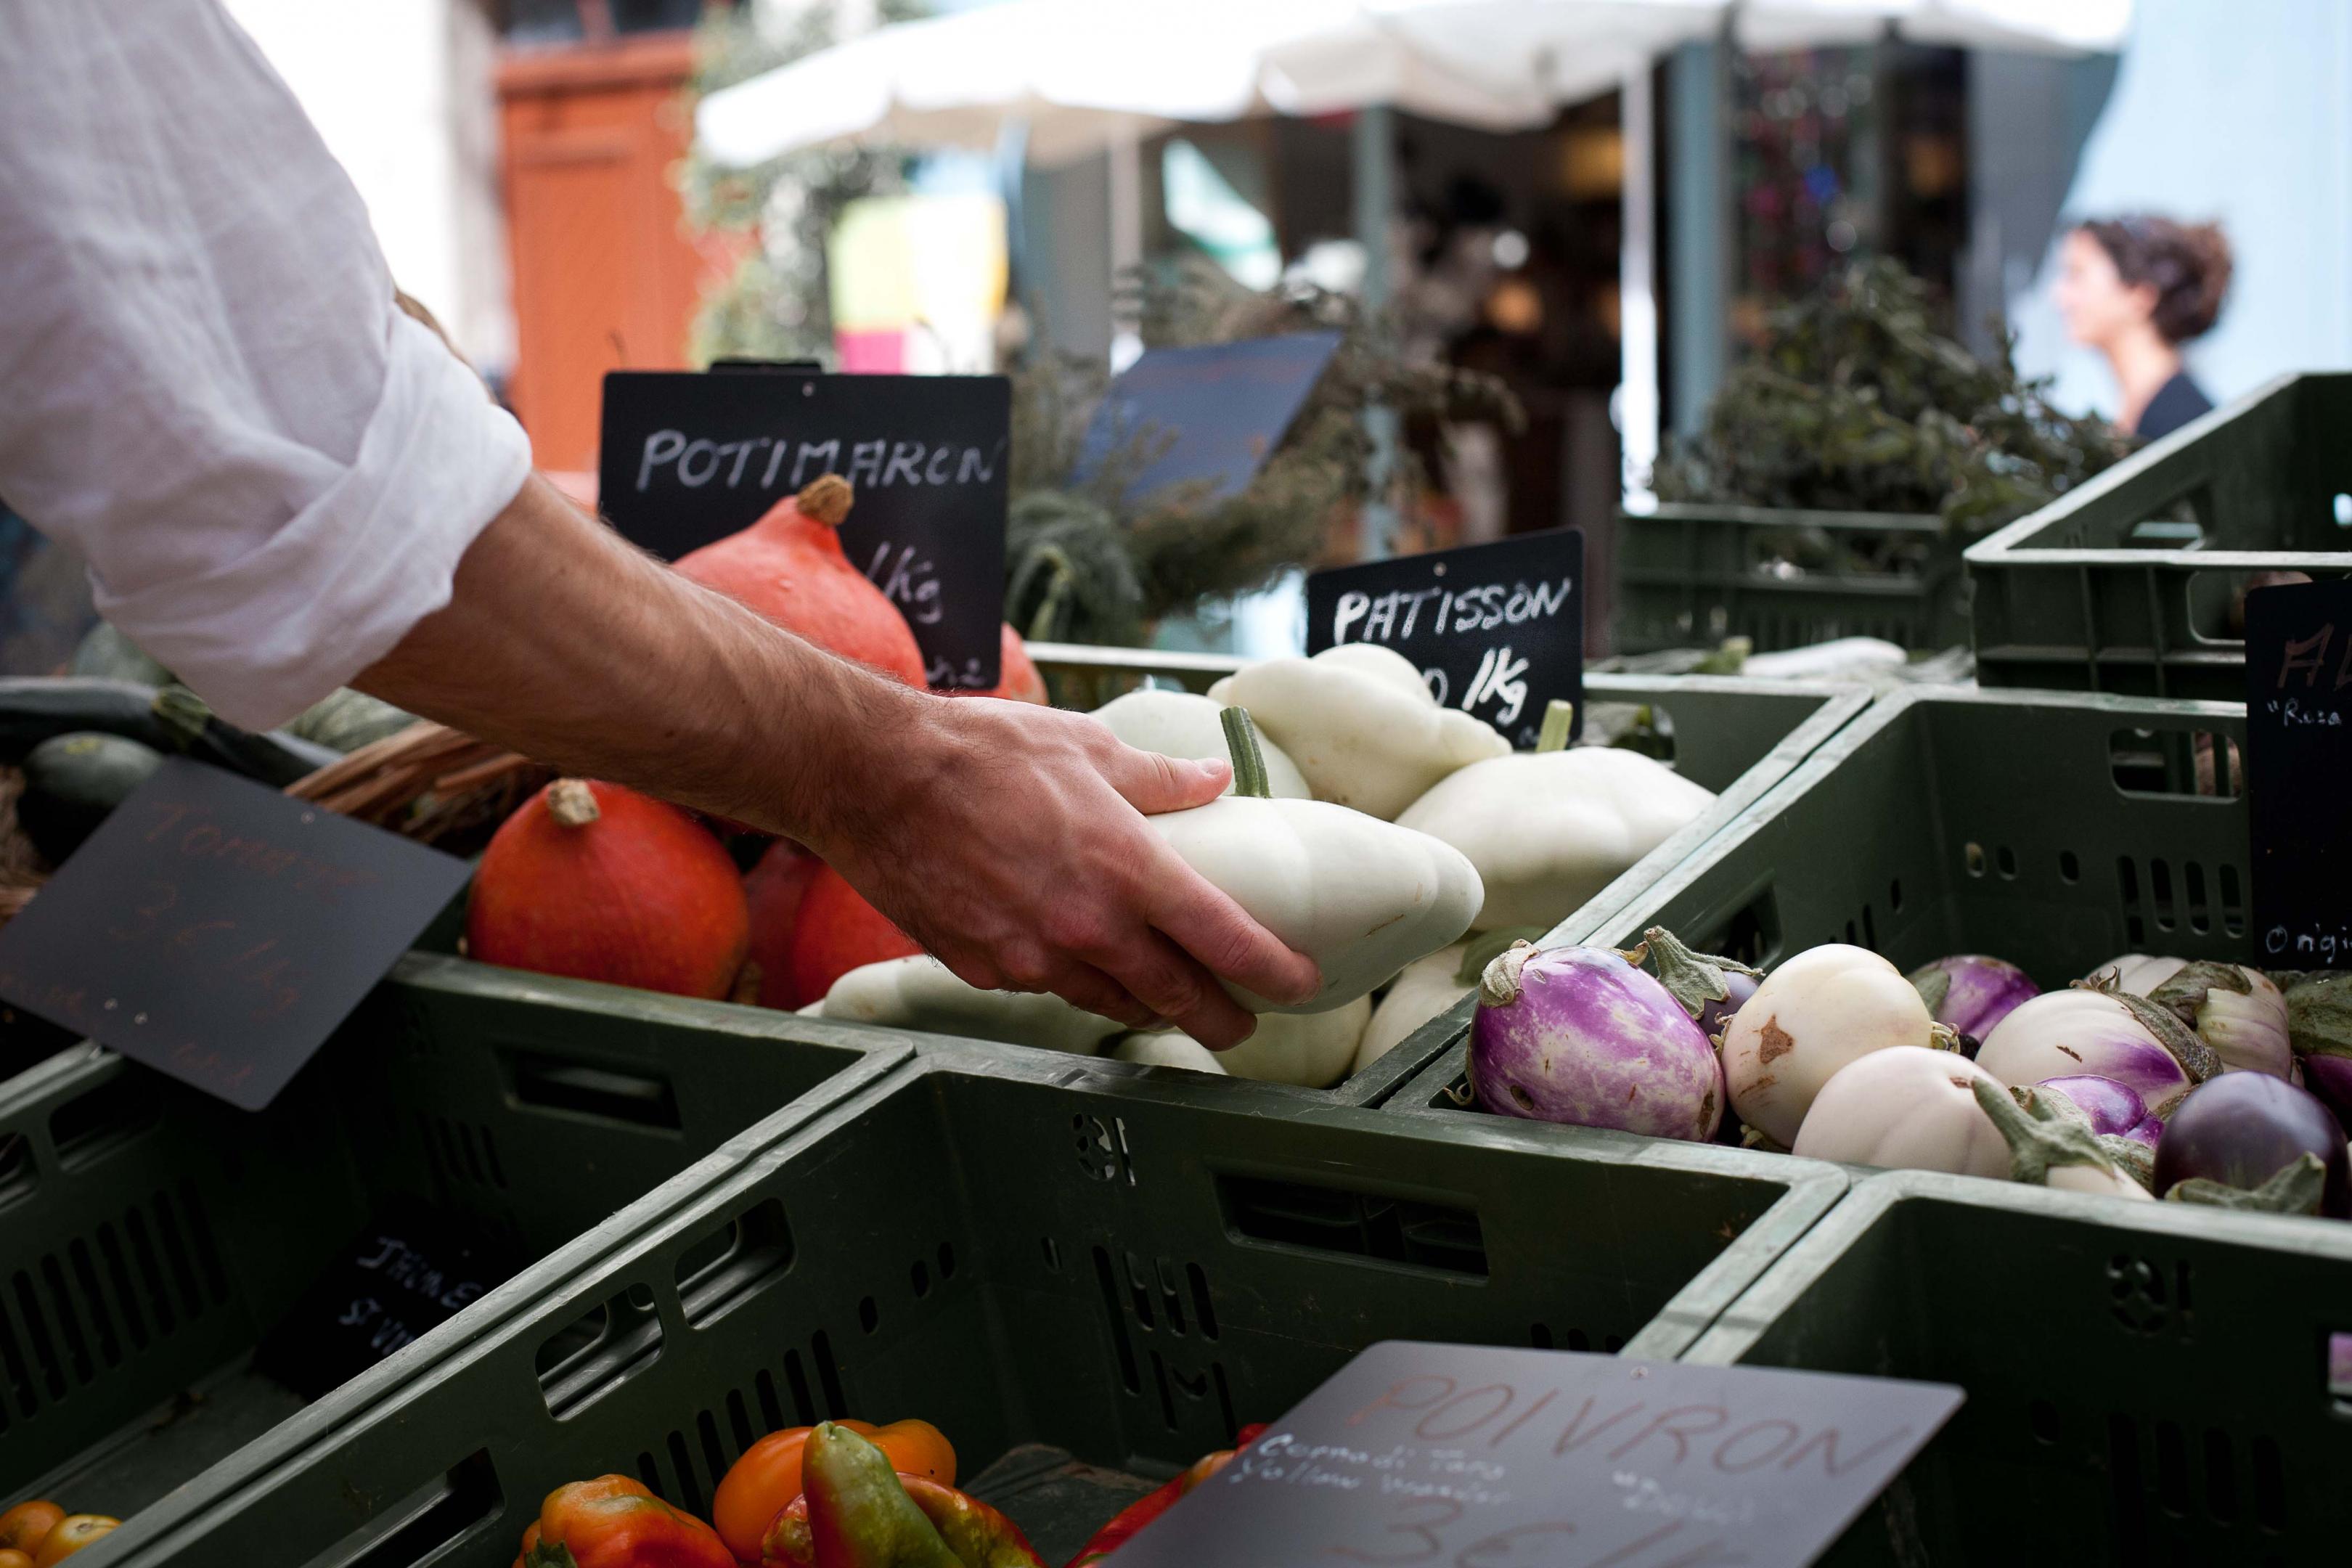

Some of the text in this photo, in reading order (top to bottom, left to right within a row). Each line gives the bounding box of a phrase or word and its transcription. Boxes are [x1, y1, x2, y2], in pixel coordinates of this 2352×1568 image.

[1334, 577, 1572, 645] PATISSON
[2266, 923, 2352, 964] Origi
[1345, 1374, 1912, 1478] POIVRON
